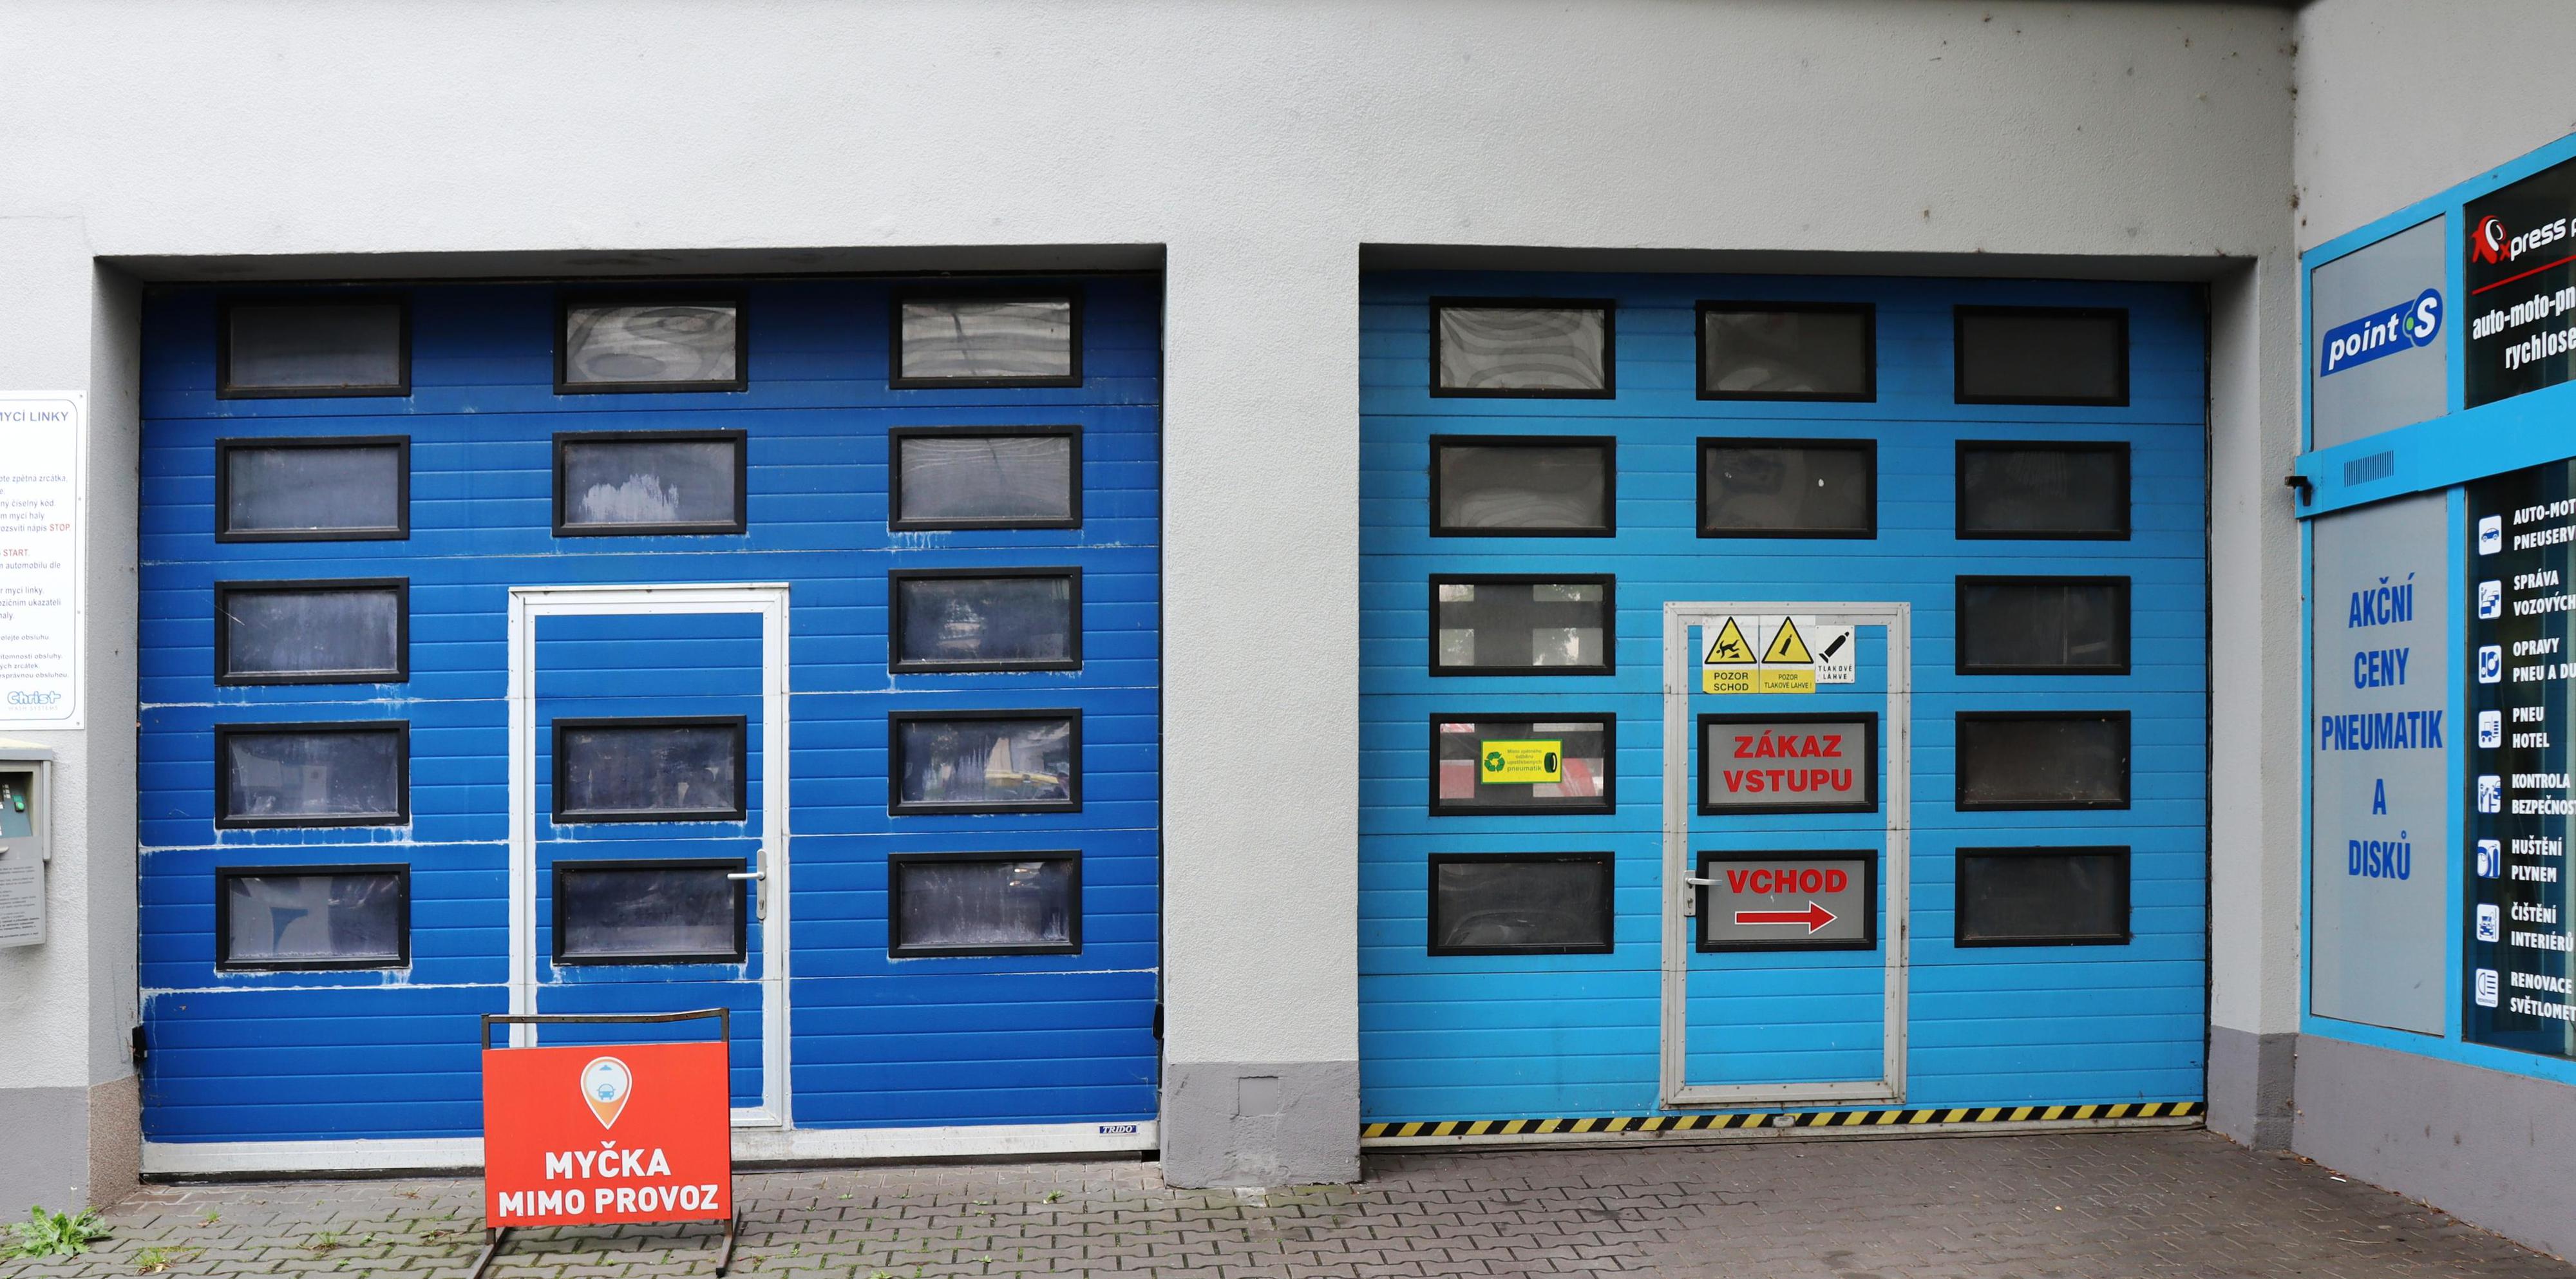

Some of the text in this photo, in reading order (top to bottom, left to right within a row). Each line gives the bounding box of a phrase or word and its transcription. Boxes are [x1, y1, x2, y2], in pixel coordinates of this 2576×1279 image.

[2472, 286, 2575, 340] auto-moto-pn
[2328, 297, 2438, 371] point S
[2505, 327, 2576, 370] rychlose
[30, 412, 69, 421] LINKY
[2514, 498, 2576, 525] AUTO-MOT
[2514, 525, 2576, 551] PNEUSERV
[2514, 569, 2559, 591] SPRÁVA
[2348, 572, 2415, 628] AKČNÍ
[2514, 591, 2576, 616] VOZOVÝCH
[2514, 638, 2560, 657] OPRAVY
[2354, 647, 2410, 689] CENY
[2513, 663, 2576, 683] PNEU A DU
[7, 690, 62, 705] Christ
[2513, 706, 2544, 723] PNEU
[2321, 710, 2443, 751] PNEUMATIK
[2512, 732, 2550, 748] HOTEL
[1734, 730, 1842, 759] ZÁKAZ
[1723, 769, 1853, 793] VSTUPU
[2512, 773, 2571, 789] KONTROLA
[2372, 779, 2387, 815] A
[2349, 830, 2410, 880] DISKŮ
[2512, 835, 2562, 857] HUŠTĚNÍ
[1727, 869, 1847, 894] VCHOD
[2512, 865, 2557, 883] PLYNEM
[2511, 902, 2557, 924] ČIŠTĚNÍ
[2511, 931, 2574, 952] INTERIÉRŮ
[2510, 971, 2573, 995] RENOVACE
[2510, 995, 2576, 1022] SVĚTLOMET
[545, 1141, 671, 1180] MYČKA
[498, 1184, 719, 1217] MIMO PROVOZ
